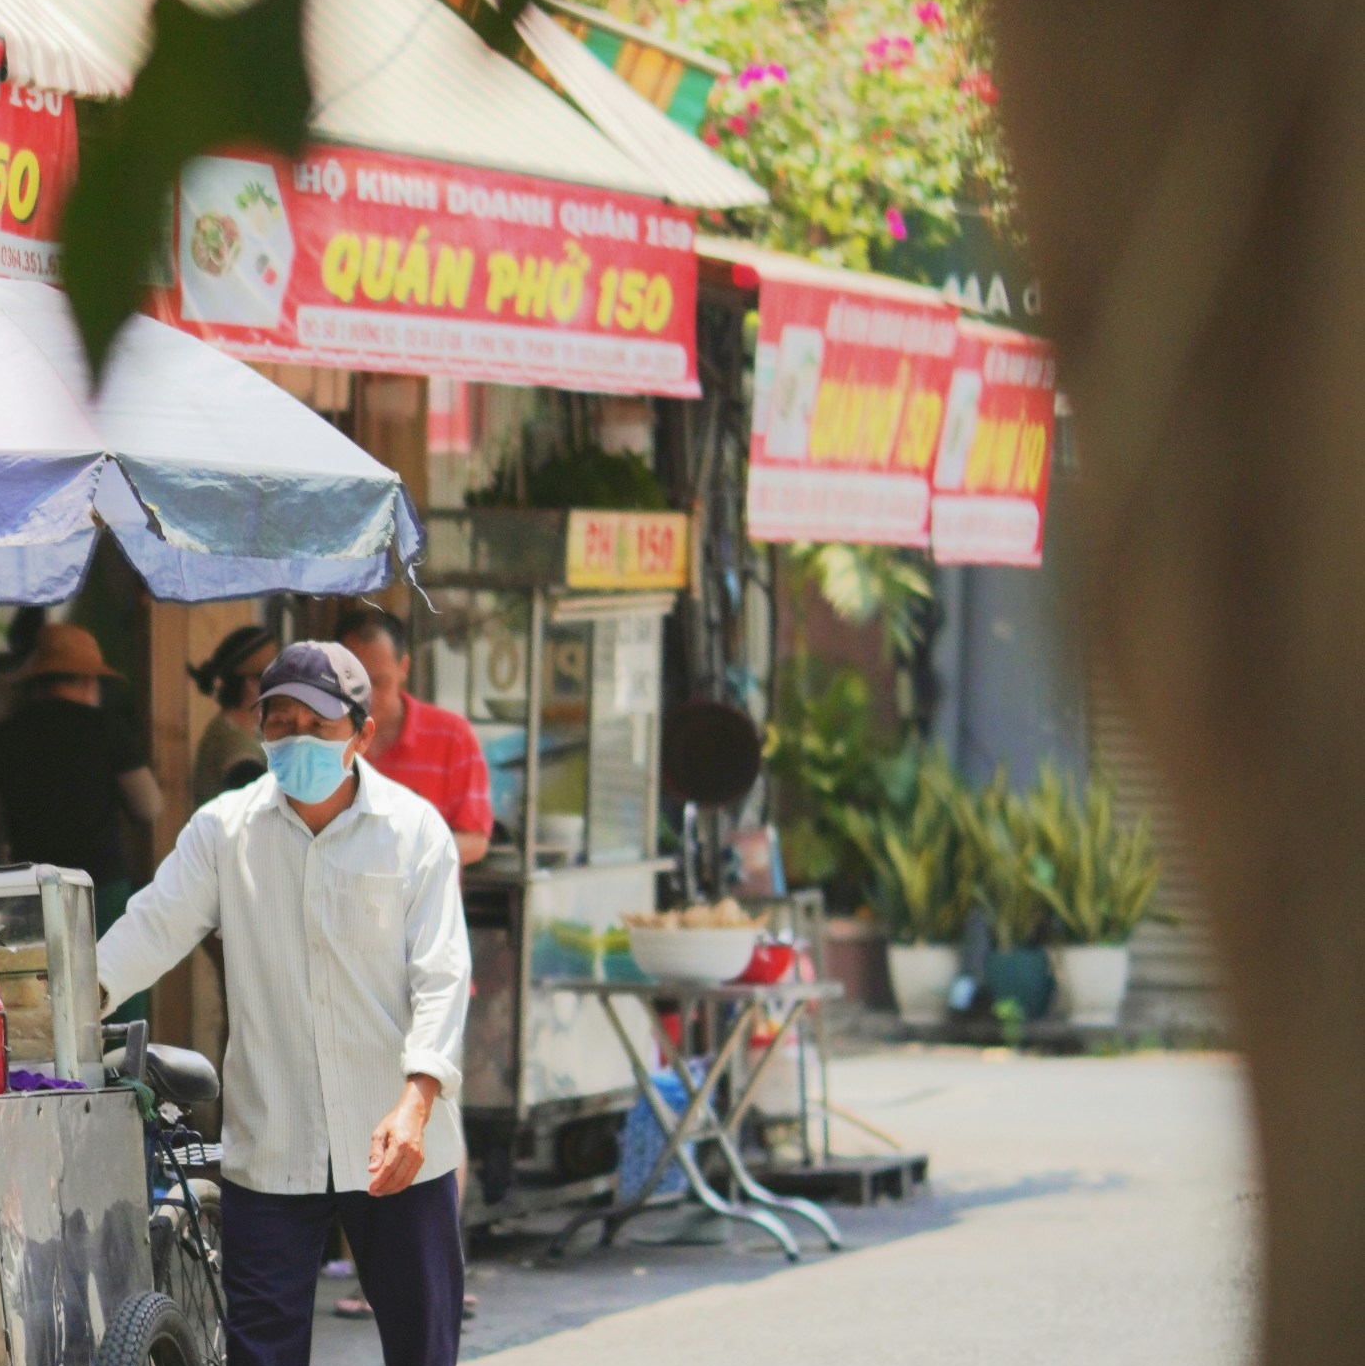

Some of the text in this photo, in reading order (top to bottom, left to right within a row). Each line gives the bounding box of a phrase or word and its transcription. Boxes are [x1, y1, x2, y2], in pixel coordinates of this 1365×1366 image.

[293, 159, 694, 251] HỘ KINH DOANH QUÁN 150
[321, 225, 674, 333] QUÁN PHỞ 150
